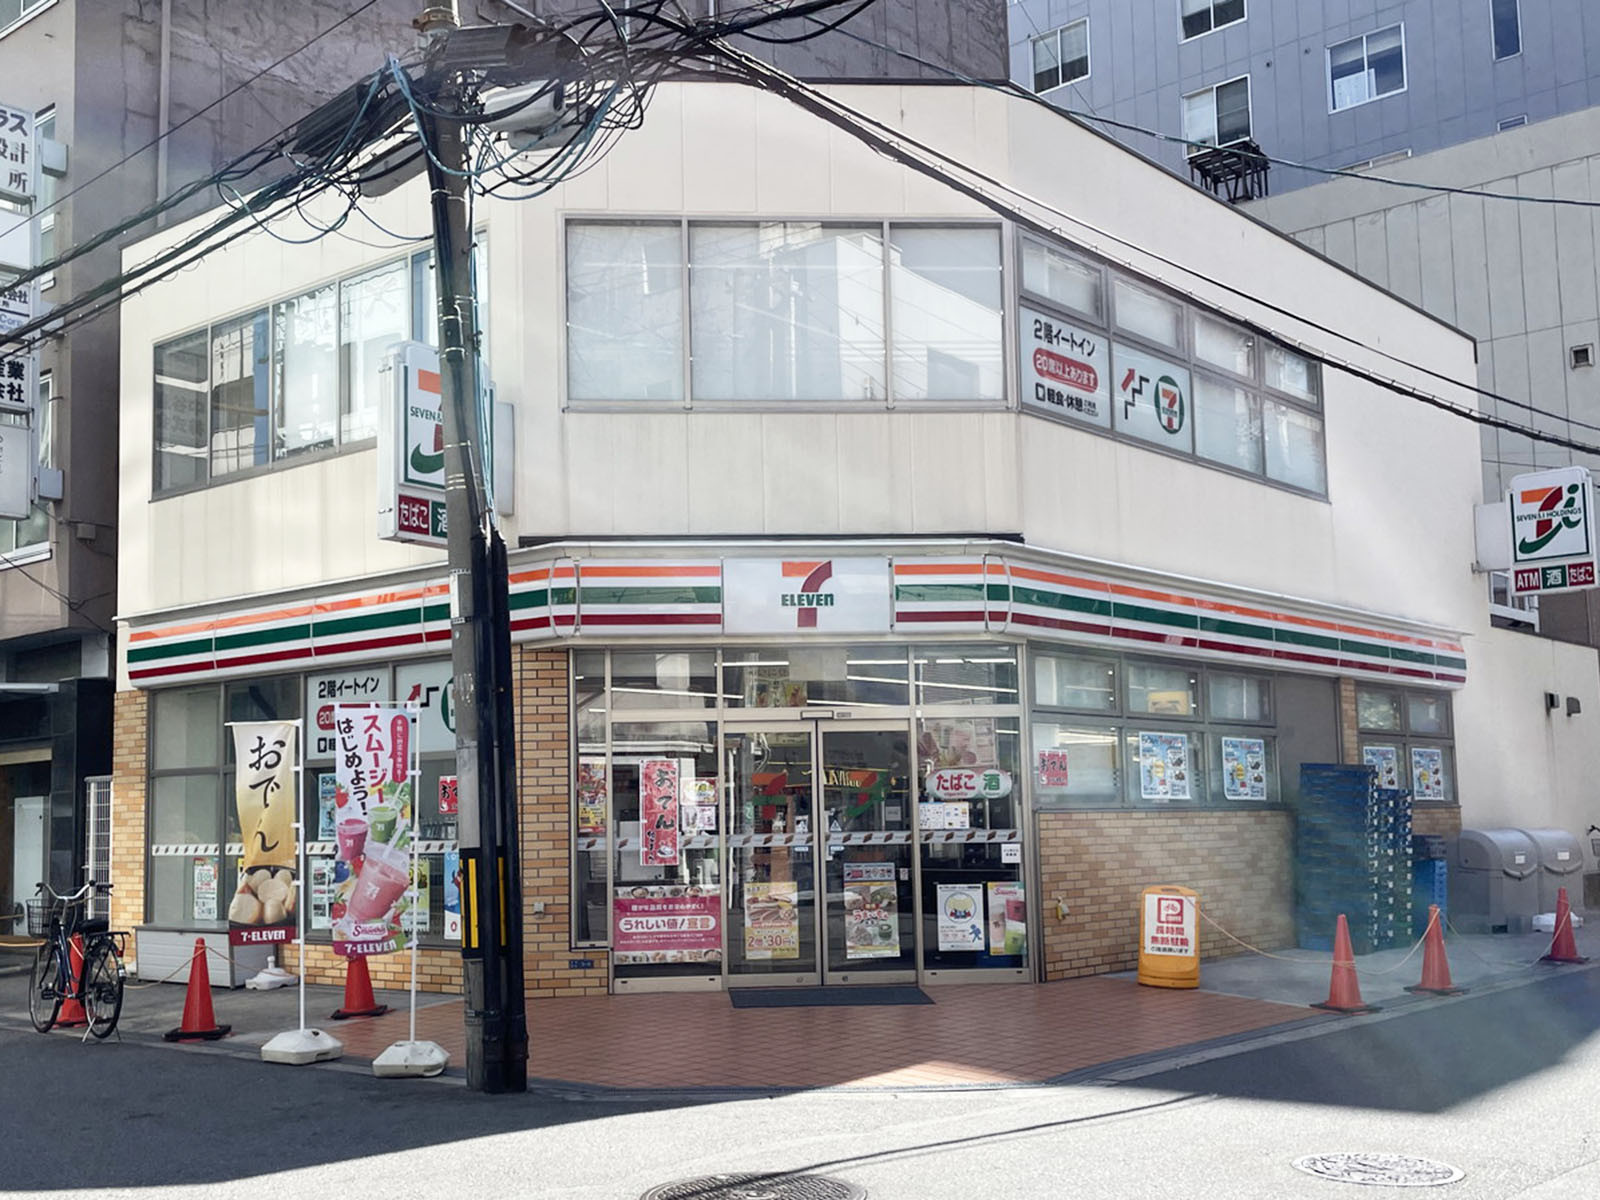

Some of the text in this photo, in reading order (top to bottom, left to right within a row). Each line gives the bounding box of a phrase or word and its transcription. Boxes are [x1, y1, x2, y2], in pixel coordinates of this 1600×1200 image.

[8, 169, 28, 193] 所
[1034, 318, 1096, 357] 2階イートイン
[410, 406, 436, 421] SEVEN
[399, 501, 429, 529] たばこ
[1516, 512, 1537, 522] SEVEN
[1546, 507, 1582, 519] HOLDINGS
[1516, 567, 1594, 588] ATM 酒 たばこ
[318, 677, 380, 699] 2階イートイン
[363, 714, 386, 804] スムージー
[936, 773, 1000, 791] たばこ 酒
[249, 735, 286, 853] おでん
